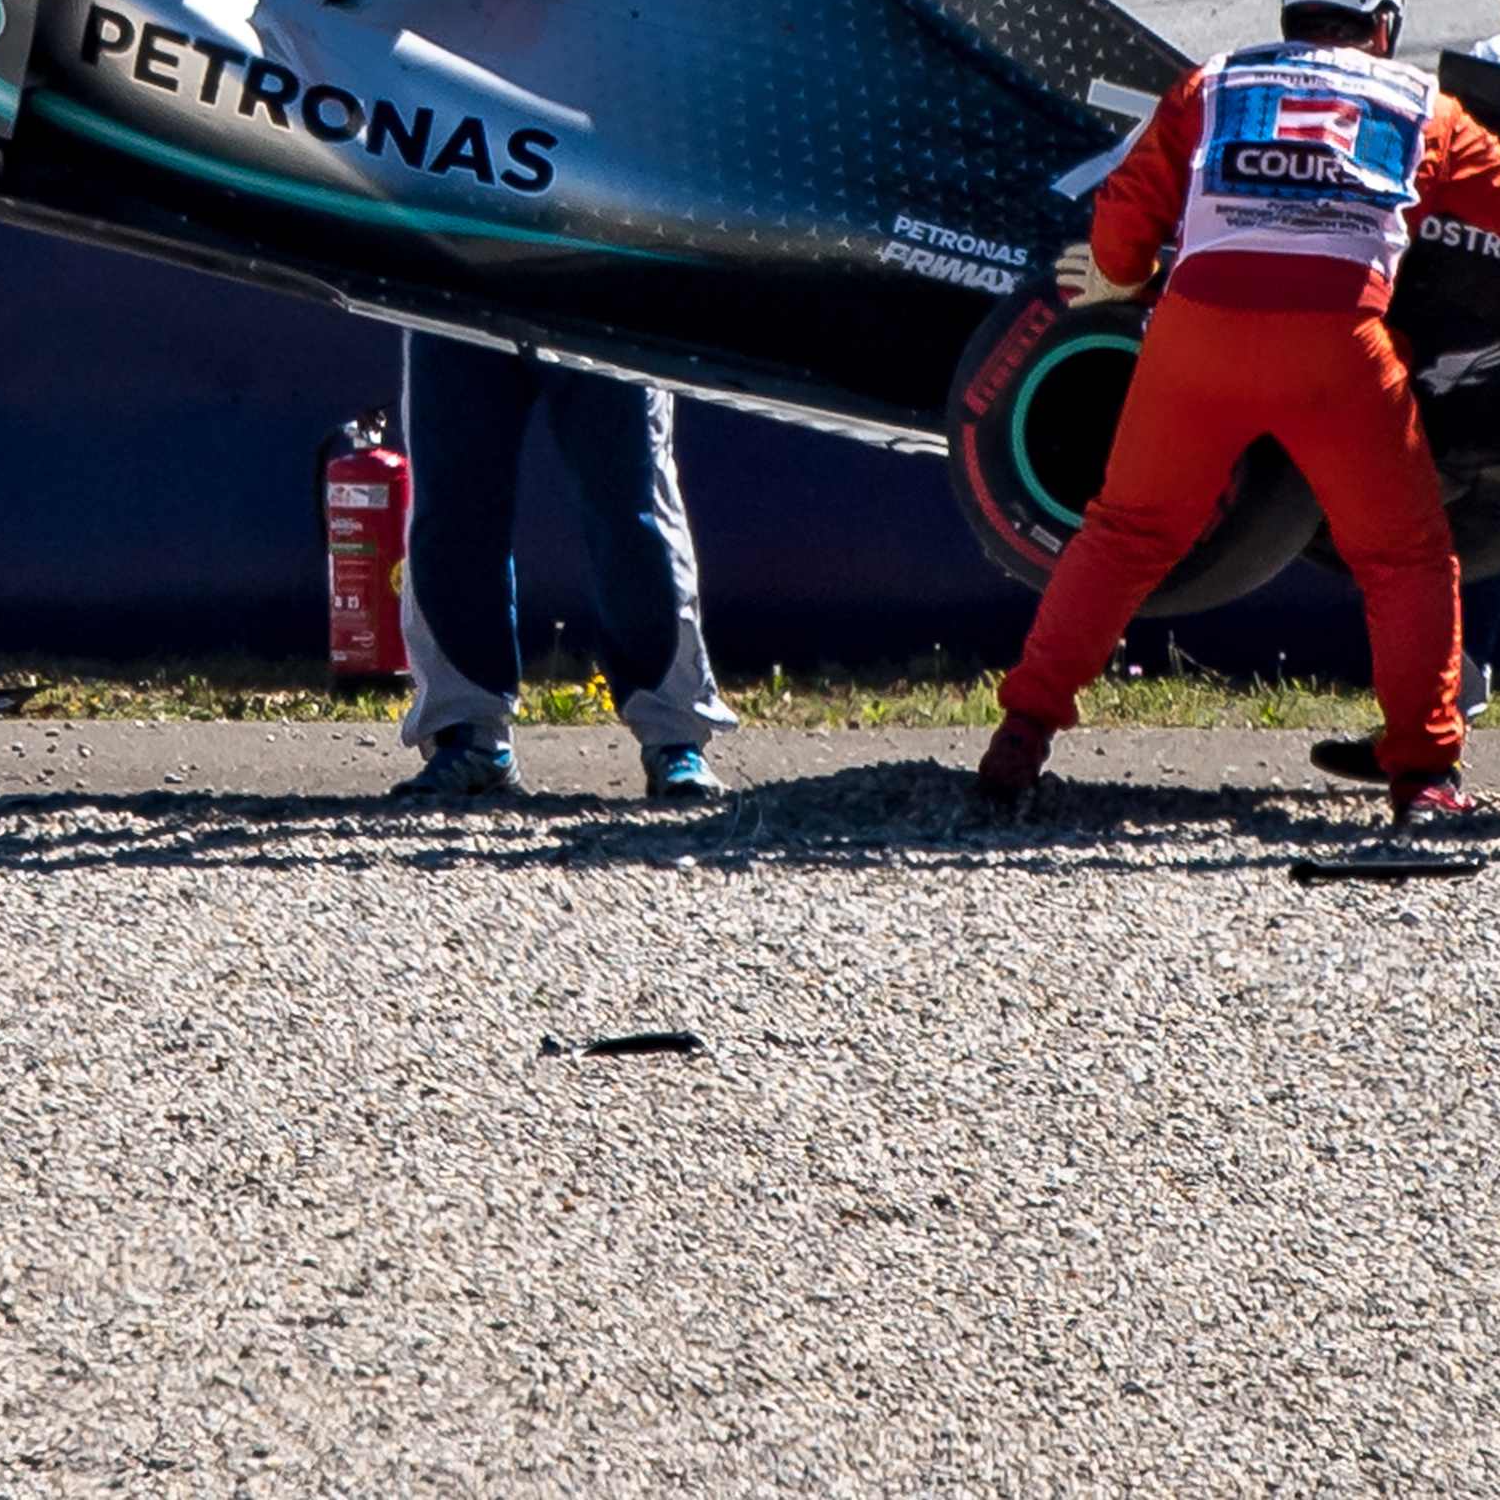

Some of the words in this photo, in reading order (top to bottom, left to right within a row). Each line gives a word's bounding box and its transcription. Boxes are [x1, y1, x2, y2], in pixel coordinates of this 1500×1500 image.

[80, 2, 560, 194] PETRONAS
[1236, 149, 1362, 187] COUR
[893, 214, 1029, 267] PETRONAS
